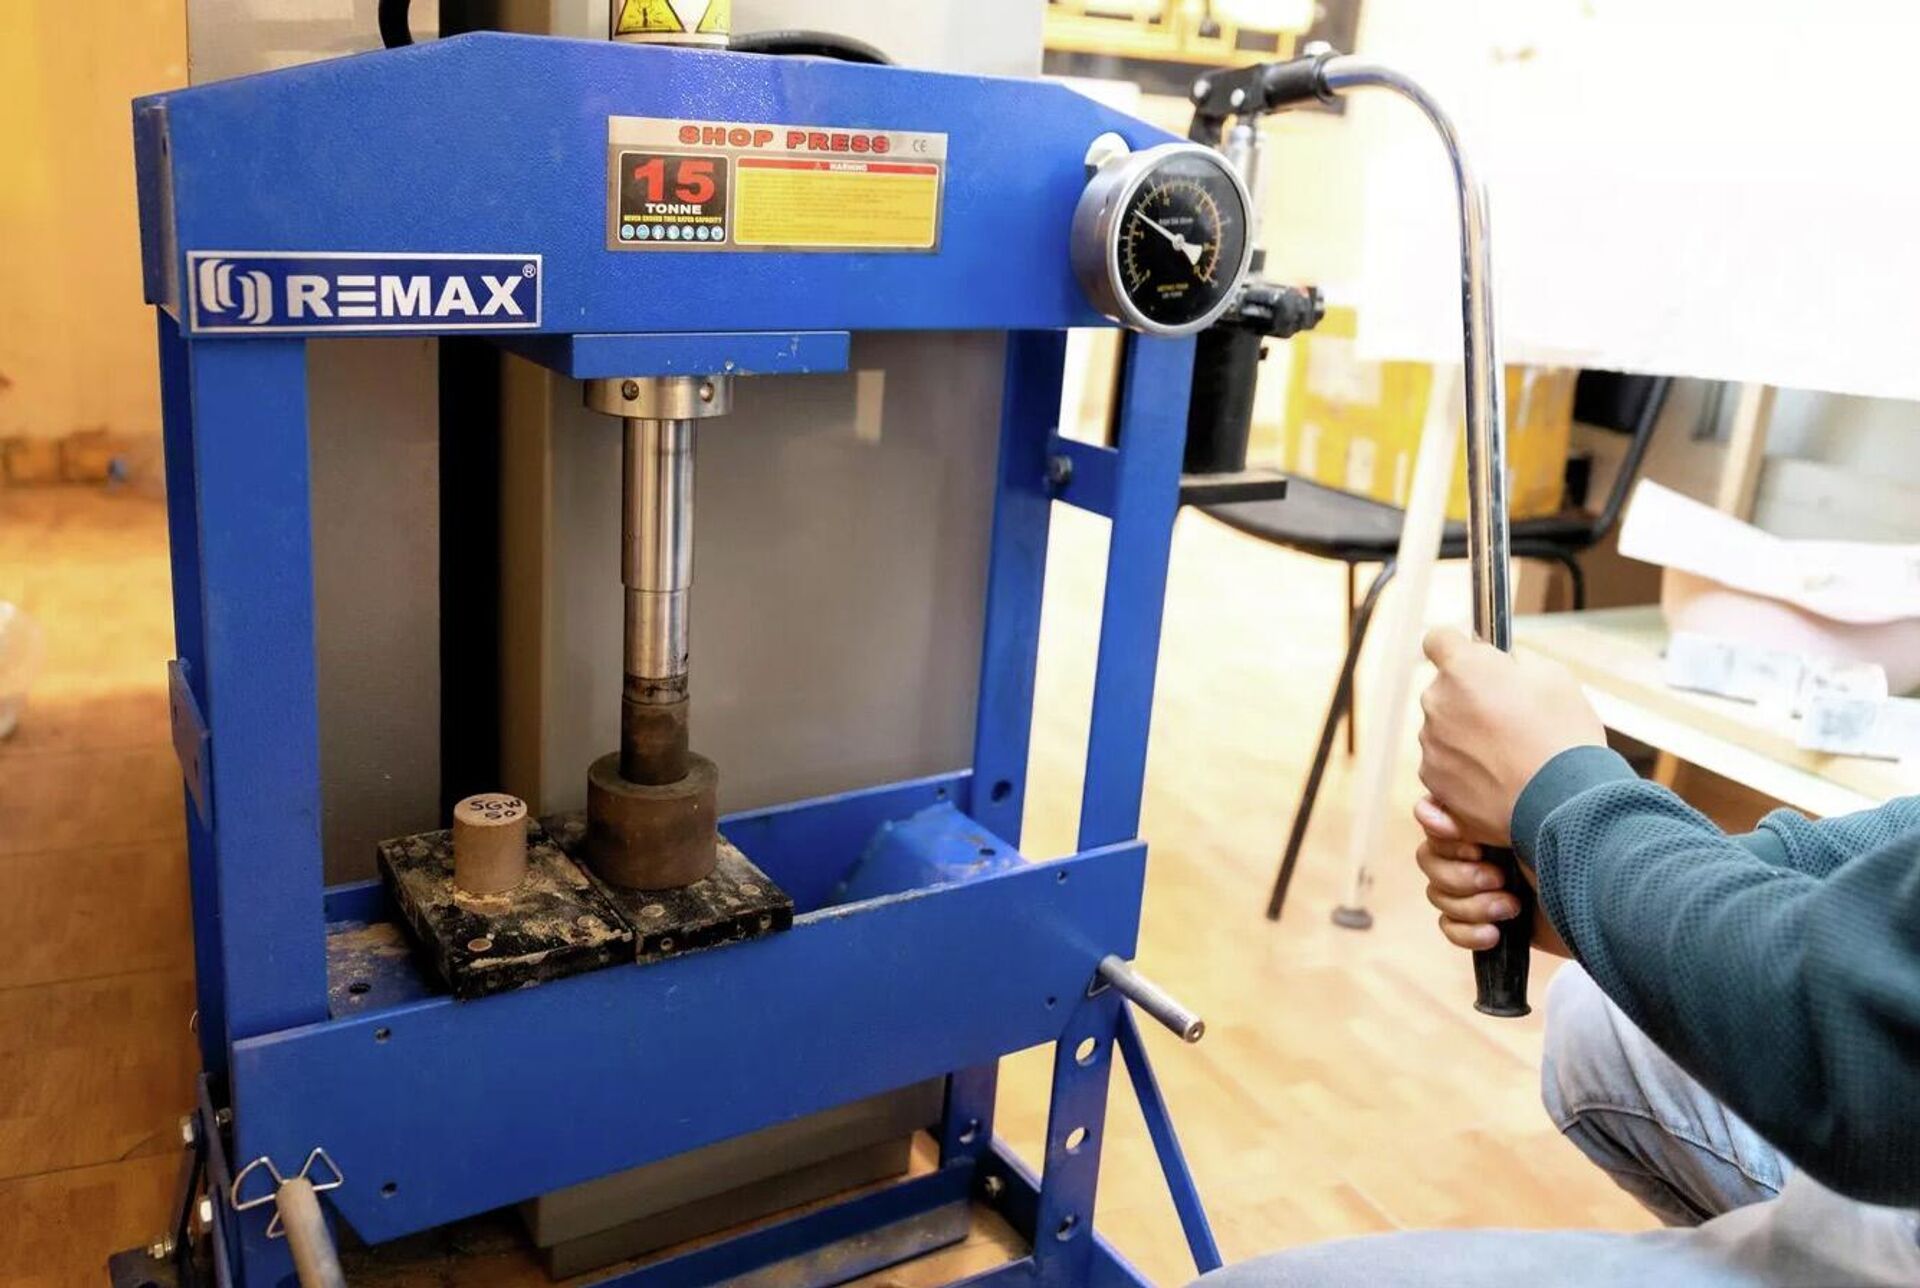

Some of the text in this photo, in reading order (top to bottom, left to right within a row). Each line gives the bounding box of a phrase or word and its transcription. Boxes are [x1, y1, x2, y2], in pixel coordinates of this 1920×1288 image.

[678, 125, 890, 154] SHOP PRESS
[829, 163, 868, 172] WARNING
[634, 155, 715, 204] 15
[645, 203, 702, 215] TONNE
[470, 800, 521, 811] SGW
